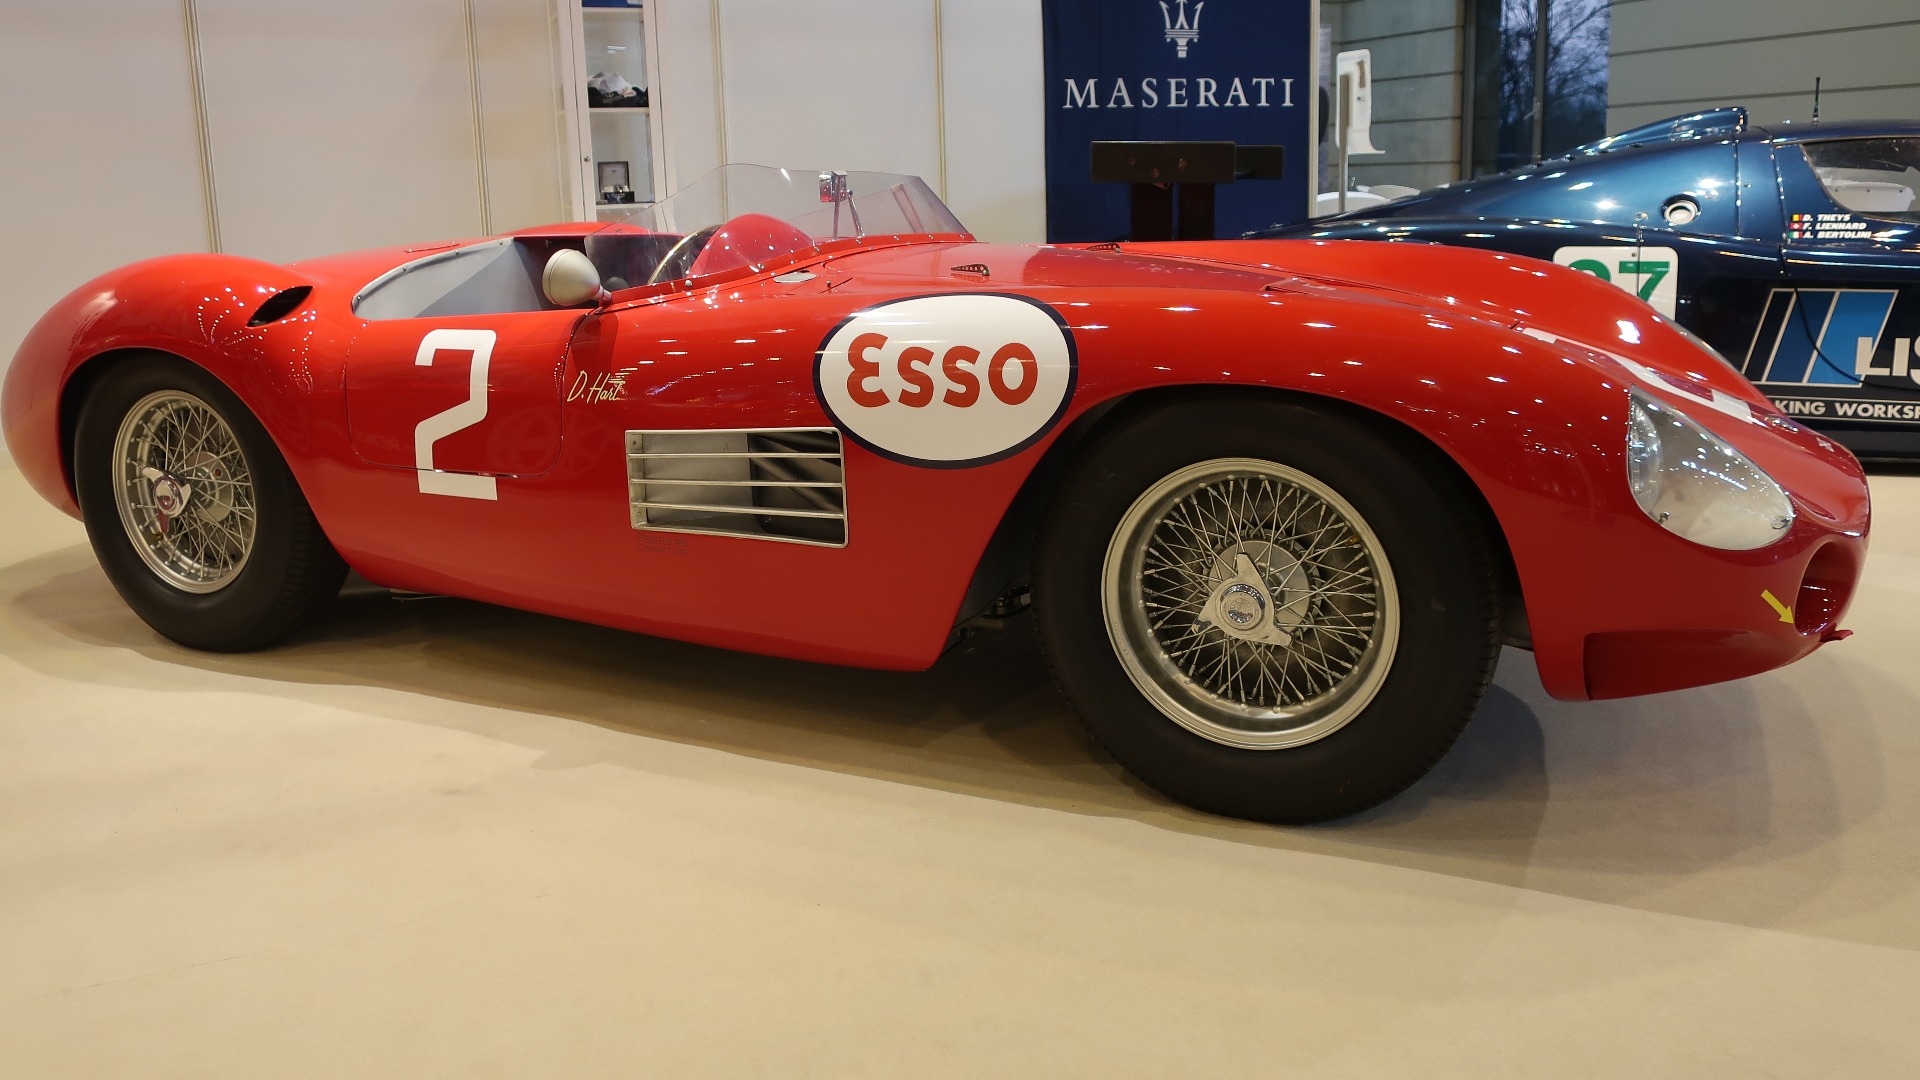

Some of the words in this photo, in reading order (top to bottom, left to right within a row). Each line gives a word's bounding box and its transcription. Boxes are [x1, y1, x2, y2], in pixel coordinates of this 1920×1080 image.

[1063, 77, 1294, 109] MASERATI
[1802, 214, 1814, 222] D.
[1817, 214, 1851, 222] THEYS
[1802, 222, 1813, 230] F.
[1815, 222, 1867, 230] LIENHARD
[1802, 231, 1814, 239] A.
[1817, 231, 1872, 239] BERTOLINI
[567, 370, 584, 402] D.
[587, 372, 626, 404] Hart
[415, 328, 497, 501] 2
